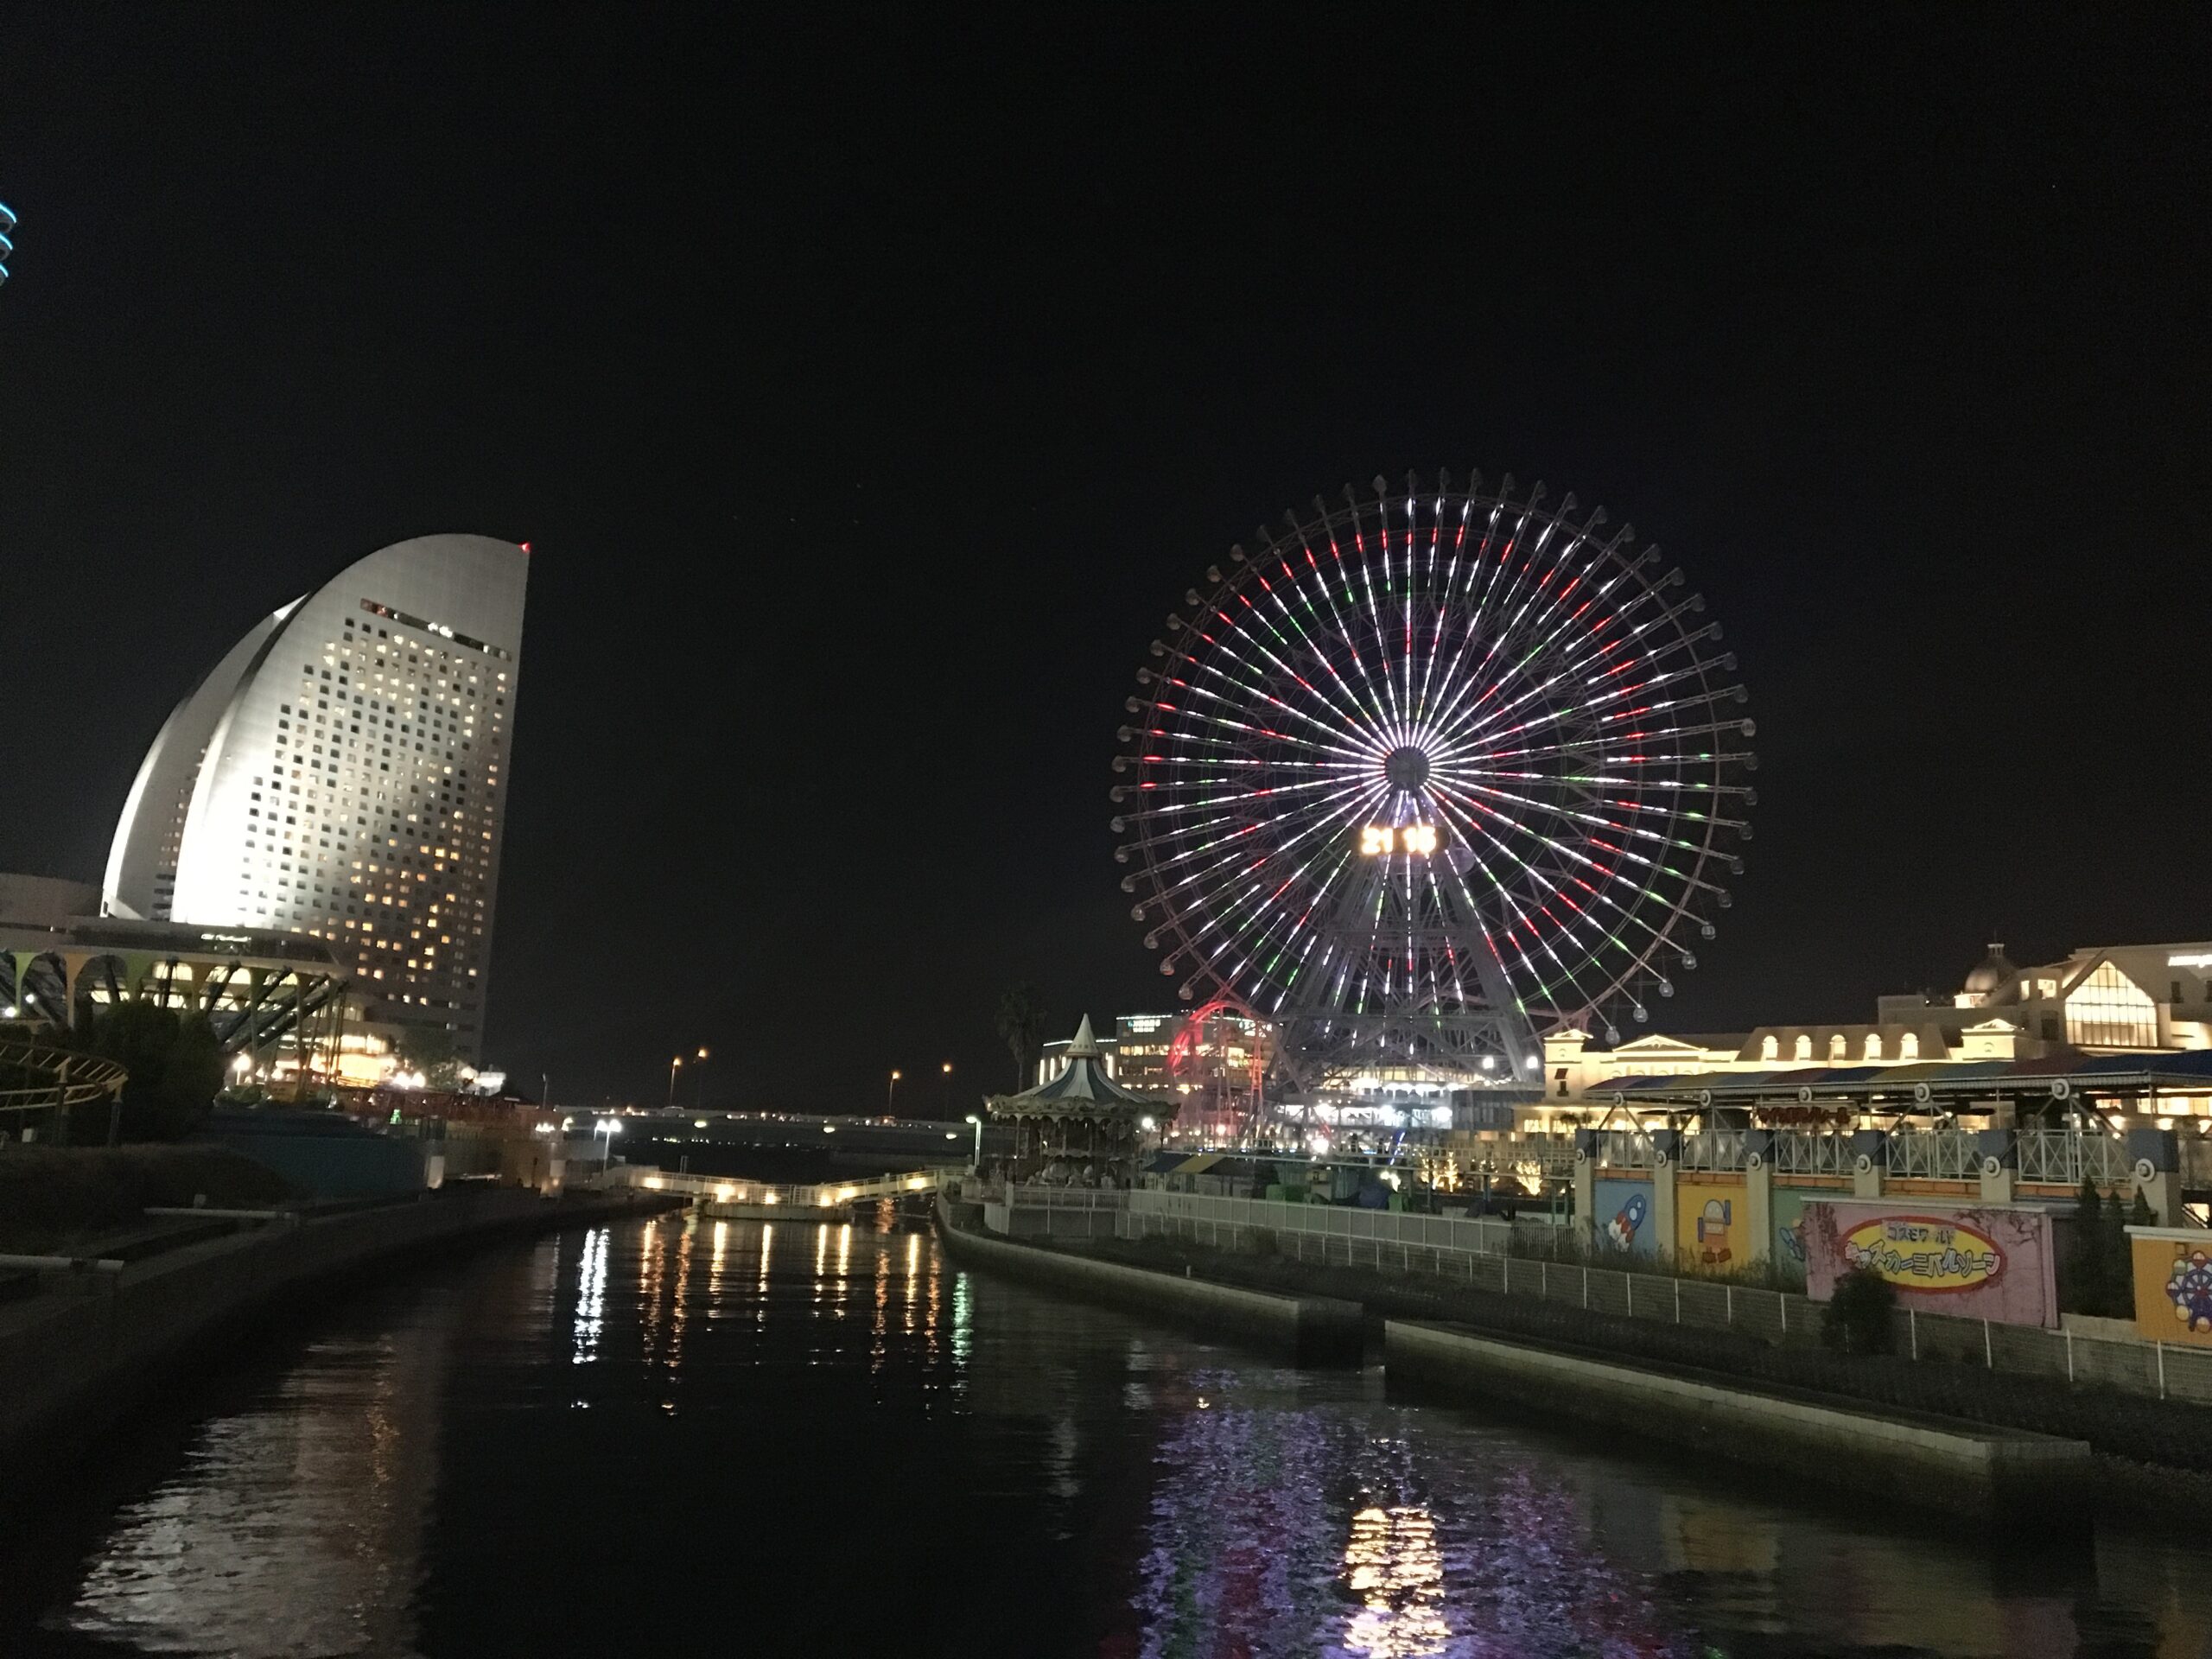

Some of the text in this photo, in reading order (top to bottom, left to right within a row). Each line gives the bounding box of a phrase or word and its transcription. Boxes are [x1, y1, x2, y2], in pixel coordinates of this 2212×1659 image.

[1886, 1226, 1955, 1245] コスモワルド
